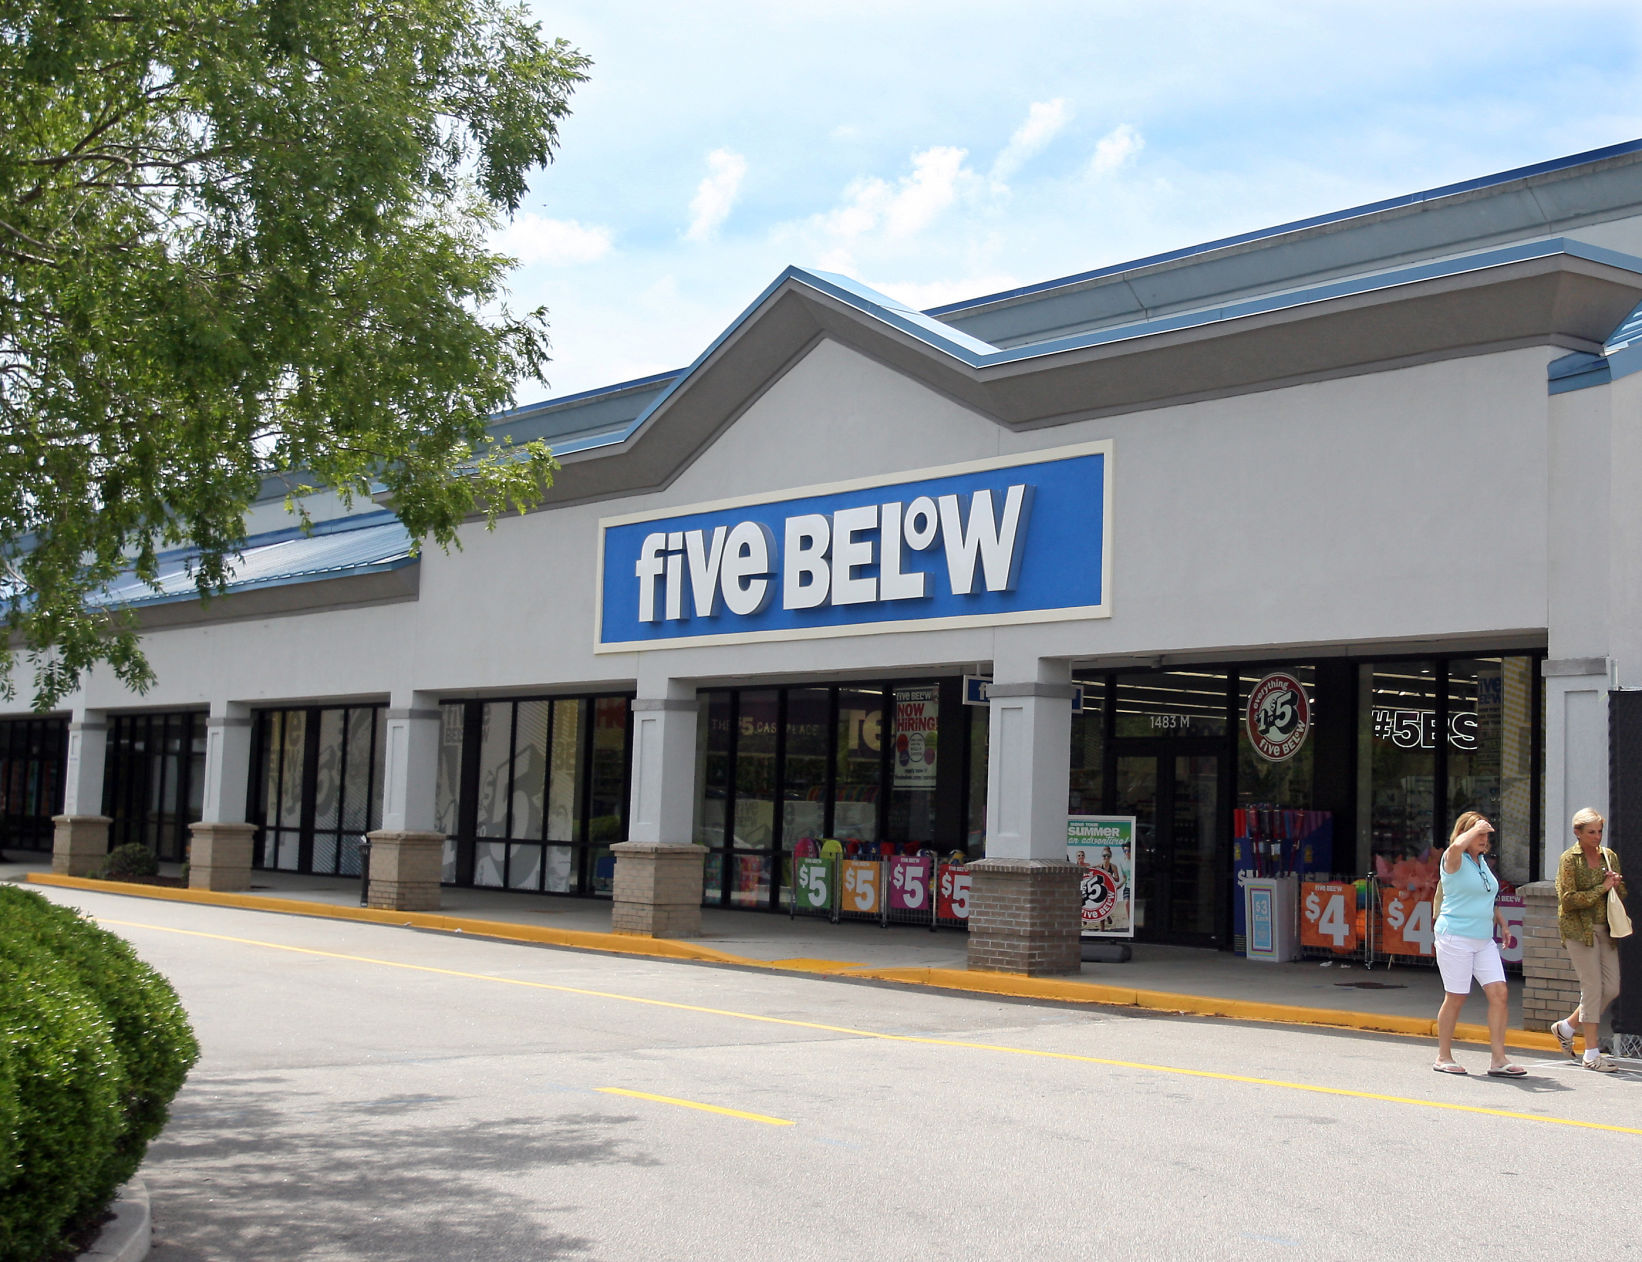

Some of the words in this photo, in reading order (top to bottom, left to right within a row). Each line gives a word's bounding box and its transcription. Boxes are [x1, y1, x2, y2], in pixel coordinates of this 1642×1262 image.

[636, 521, 773, 622] five
[783, 484, 1030, 611] BELOW
[897, 703, 925, 717] NOW
[1253, 679, 1289, 709] everything
[1150, 716, 1176, 728] 1483
[1180, 715, 1190, 728] M
[1259, 738, 1280, 756] five
[1283, 720, 1305, 754] BELOW
[799, 864, 827, 908] $5
[845, 869, 875, 911] $5
[893, 864, 923, 909] $5
[941, 875, 971, 919] $5
[1304, 892, 1350, 946] $4
[1387, 897, 1434, 954] $4
